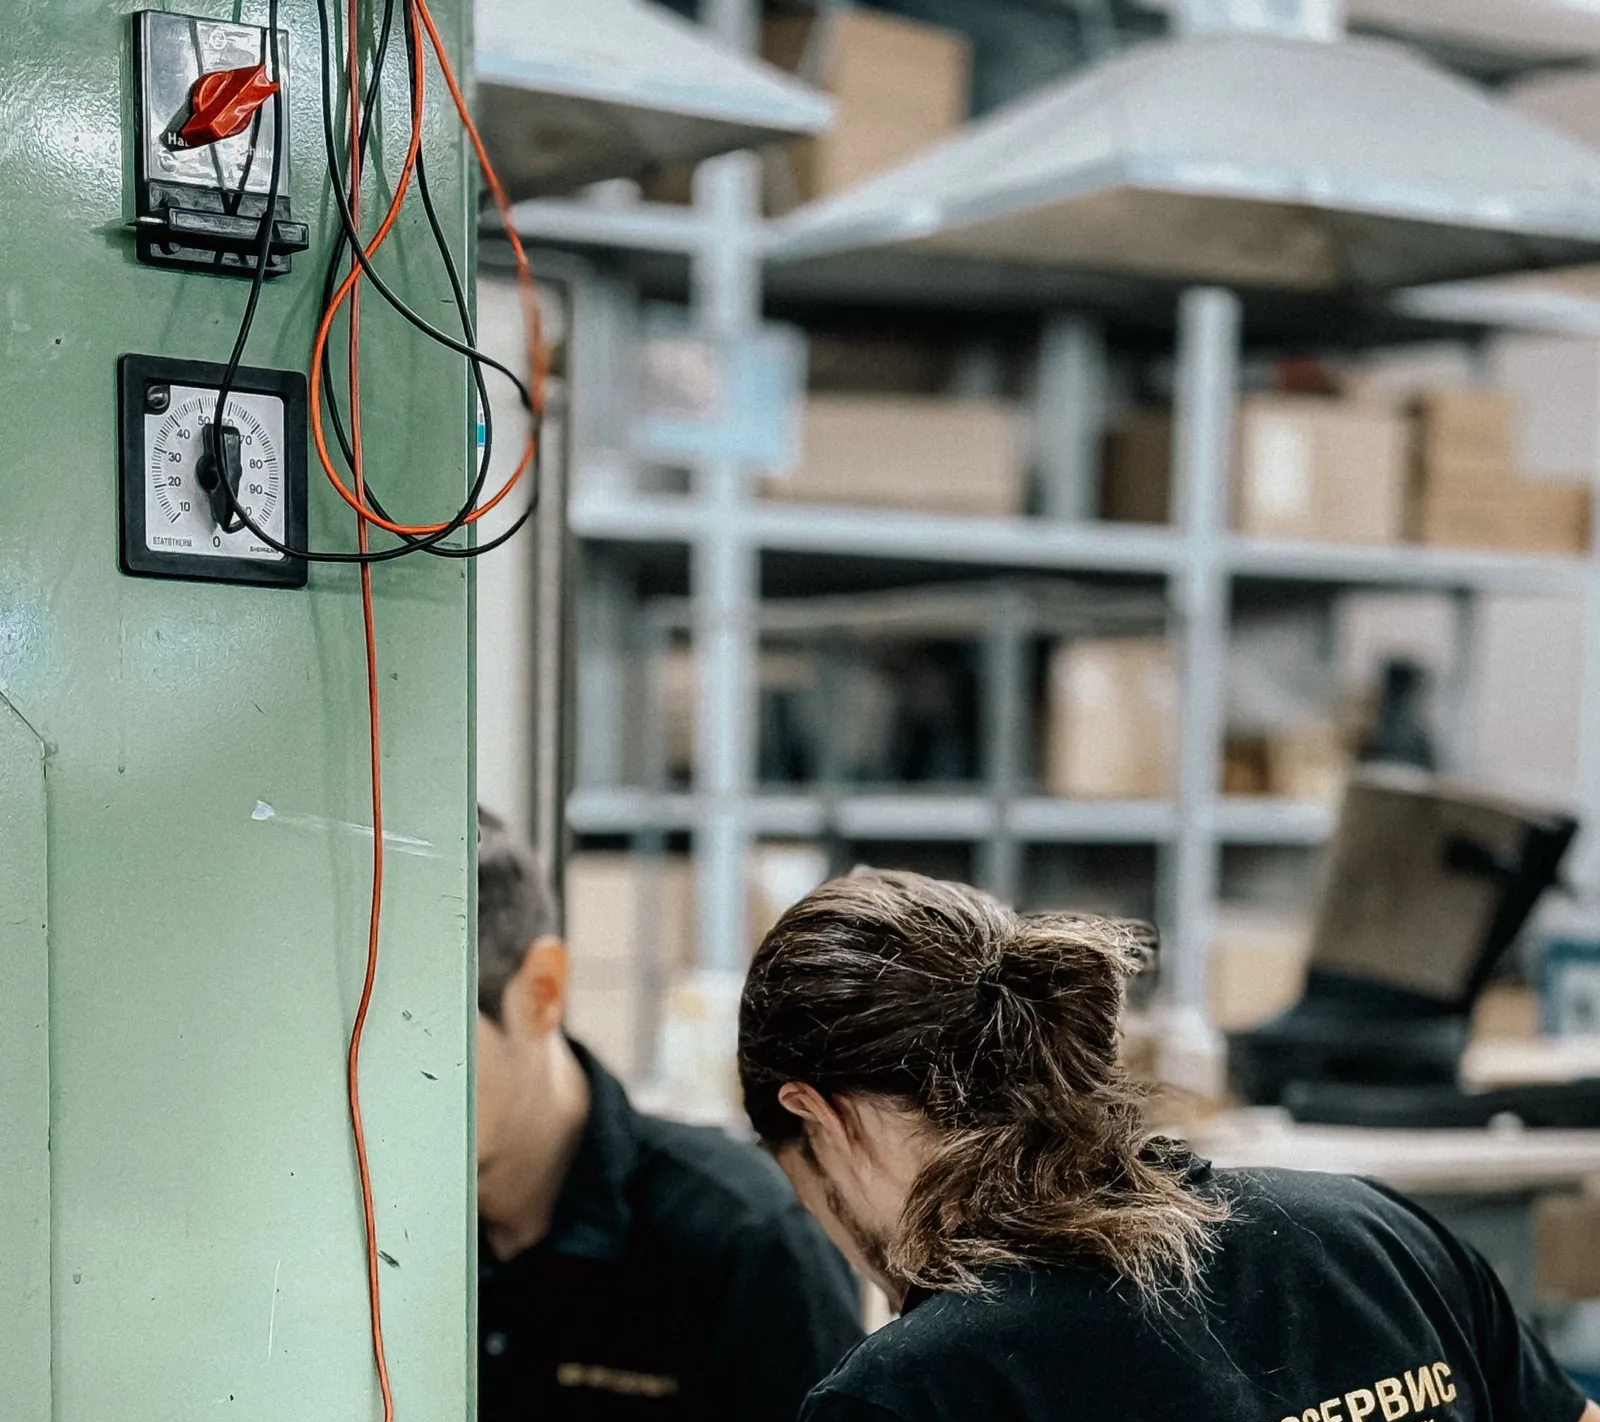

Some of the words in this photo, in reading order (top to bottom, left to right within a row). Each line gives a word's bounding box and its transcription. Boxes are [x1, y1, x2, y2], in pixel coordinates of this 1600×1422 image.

[176, 429, 191, 440] 40
[239, 434, 253, 446] 70
[168, 452, 182, 462] 30
[249, 459, 263, 470] 80
[168, 476, 182, 487] 20
[249, 484, 263, 495] 90
[179, 501, 191, 512] 10
[212, 535, 221, 548] 0
